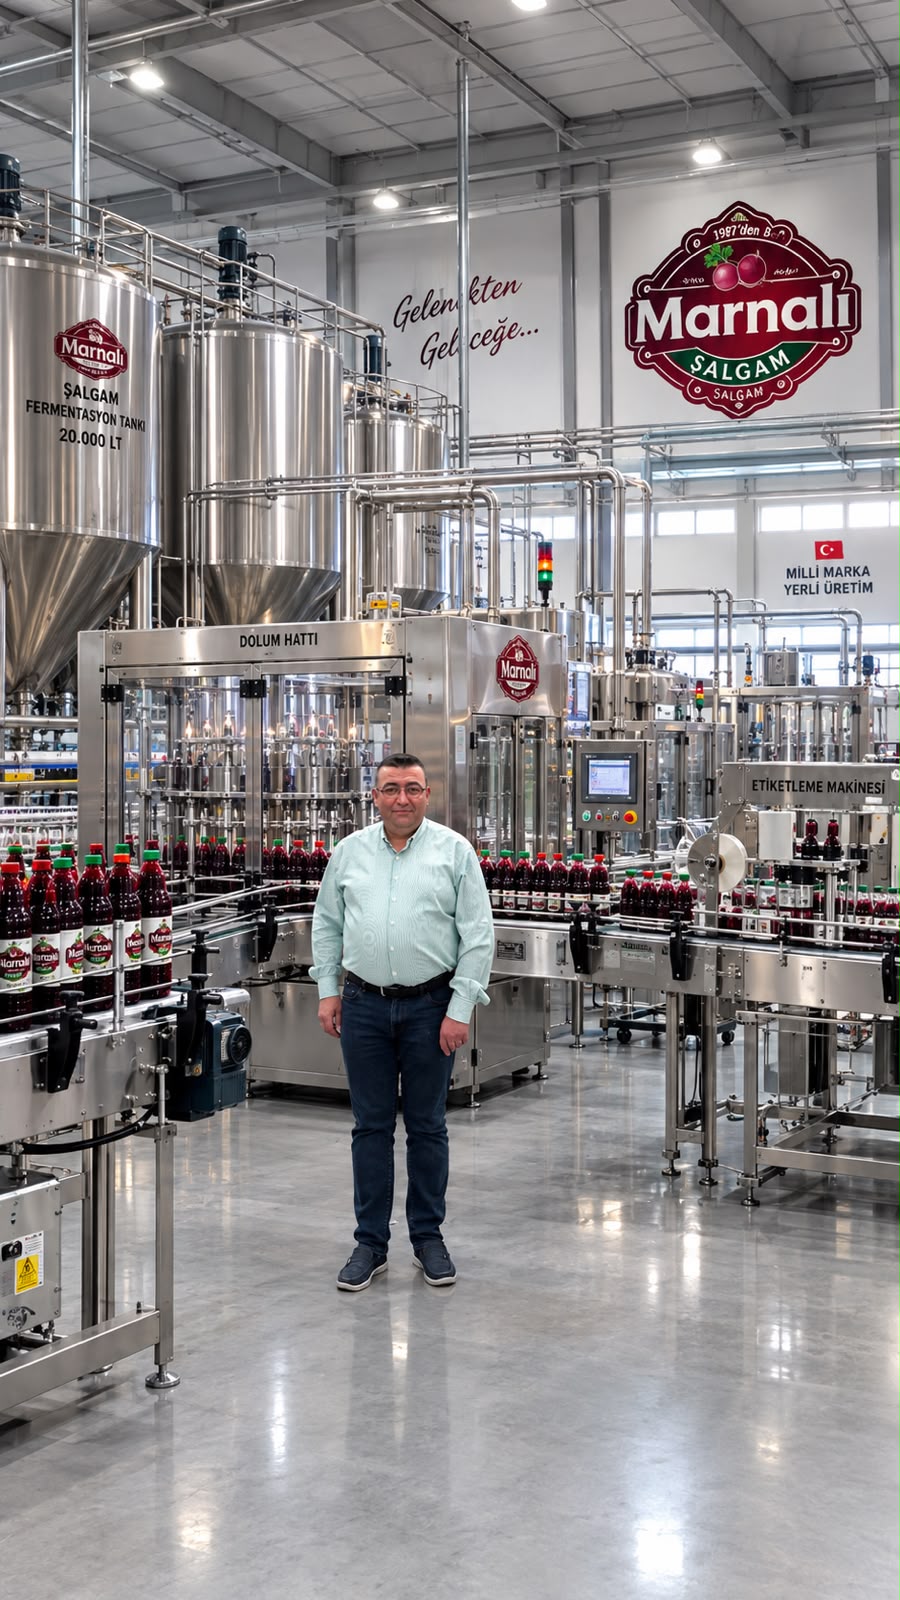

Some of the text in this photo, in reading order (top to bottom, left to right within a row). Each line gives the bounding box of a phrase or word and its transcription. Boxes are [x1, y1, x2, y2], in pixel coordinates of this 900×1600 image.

[713, 223, 760, 240] 1987'den
[393, 275, 523, 333] Gelenkten
[634, 283, 851, 344] Marnalı
[61, 337, 124, 366] Marnalı
[420, 317, 539, 370] Gelceğe...
[690, 350, 791, 380] ŞALGAM
[63, 382, 119, 405] ŞALGAM
[713, 386, 764, 401] SALGAM
[26, 399, 146, 432] FERMENTASYON TANKI
[59, 428, 122, 450] 20.000 LT
[786, 565, 871, 579] MİLLİ MARKA
[784, 580, 873, 596] YERLİ ÜRETİM
[239, 632, 318, 648] DOLUM HATTI
[752, 777, 886, 795] ETİKETLEME MAKİNESİ
